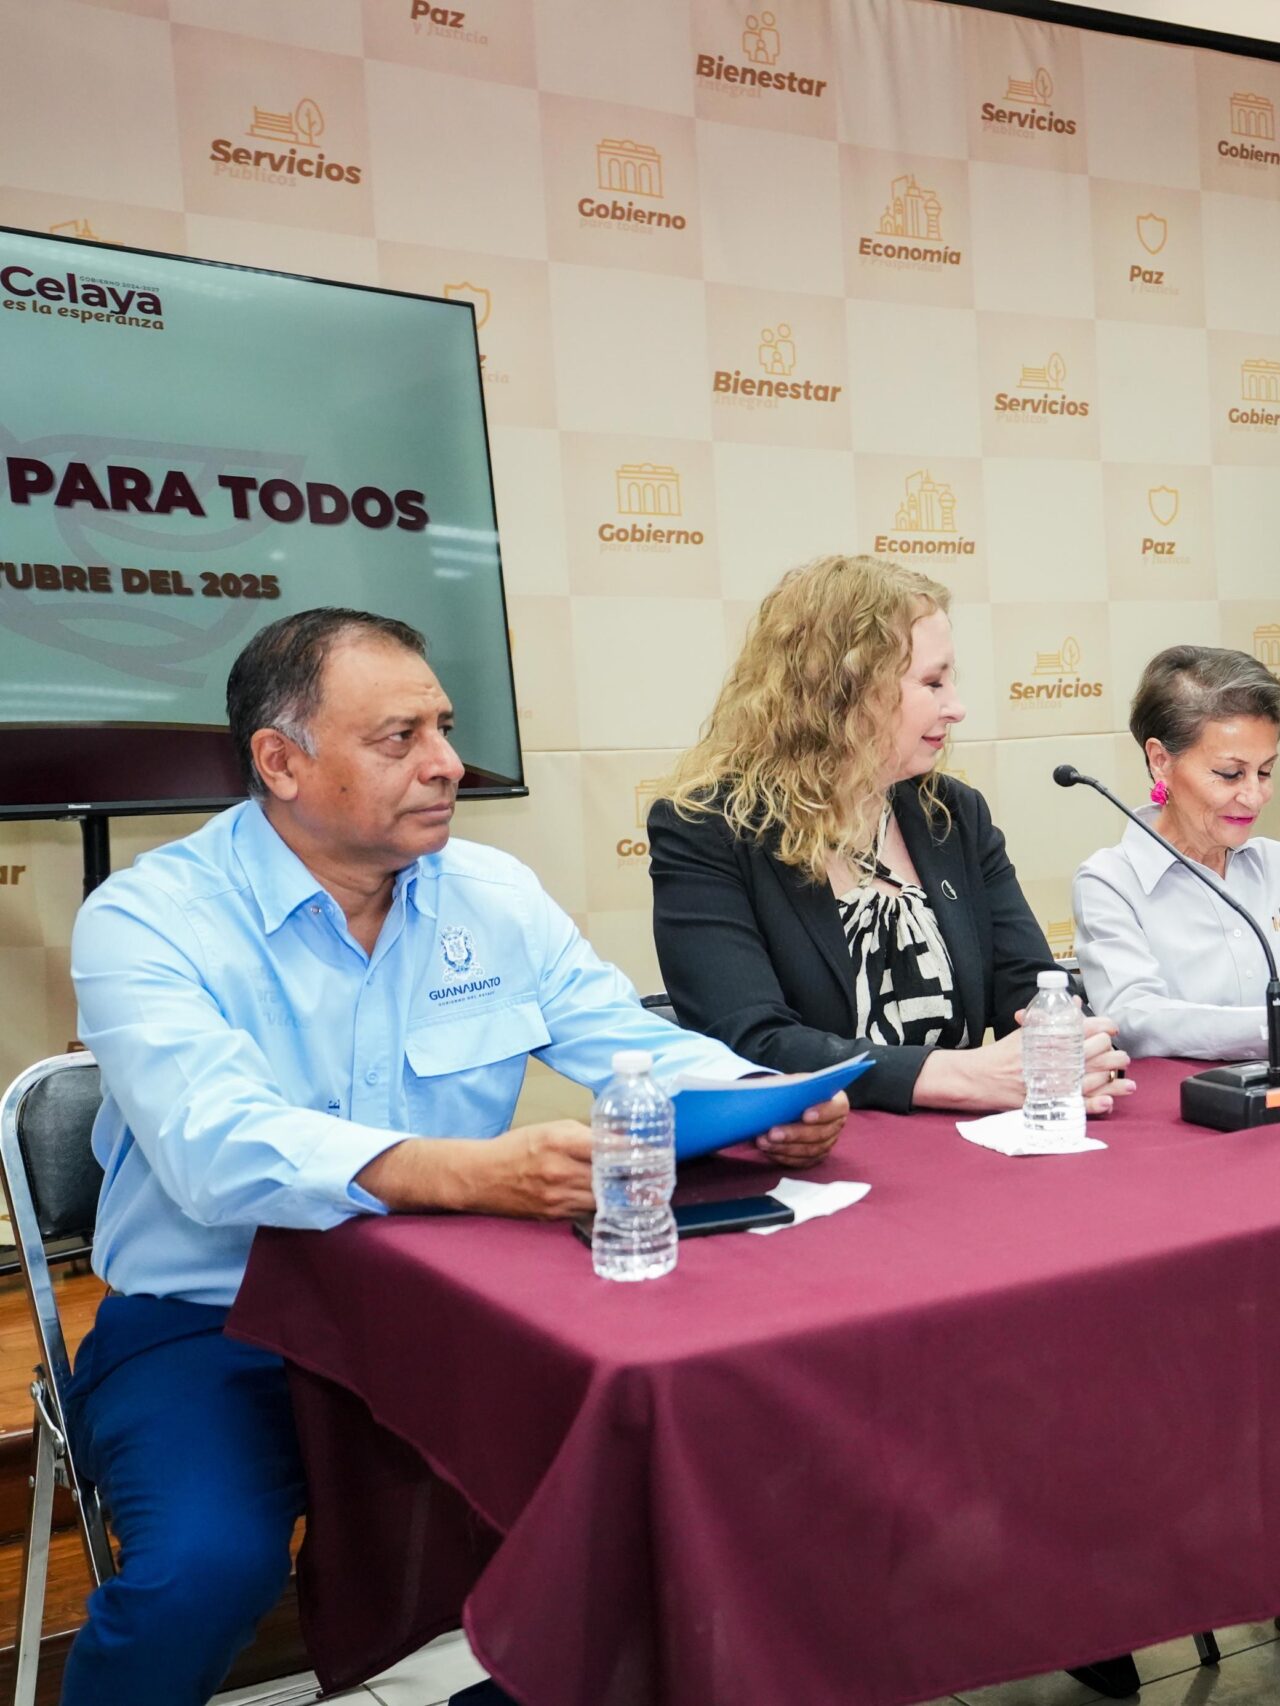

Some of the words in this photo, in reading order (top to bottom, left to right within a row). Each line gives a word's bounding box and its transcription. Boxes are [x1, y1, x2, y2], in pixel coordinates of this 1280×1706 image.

[410, 0, 465, 28] Paz
[696, 53, 827, 97] Bienestar
[981, 102, 1076, 135] Servicios
[210, 139, 362, 184] Servicios
[578, 198, 686, 230] Gobierno
[859, 237, 961, 265] Economía
[1128, 264, 1164, 284] Paz
[0, 265, 162, 316] Celaya
[3, 299, 26, 311] es
[32, 300, 52, 314] la
[57, 306, 164, 330] esperanza
[713, 370, 842, 402] Bienestar
[994, 392, 1089, 416] Servicios
[6, 456, 208, 519] PARA
[218, 473, 430, 532] TODOS
[598, 522, 704, 545] Gobierno
[874, 536, 975, 554] Economía
[1142, 538, 1175, 555] Paz
[0, 562, 113, 594] UBRE
[121, 567, 194, 597] DEL
[200, 571, 281, 600] 2025
[1009, 677, 1103, 700] Servicios
[429, 976, 501, 1001] GUANAJUATO
